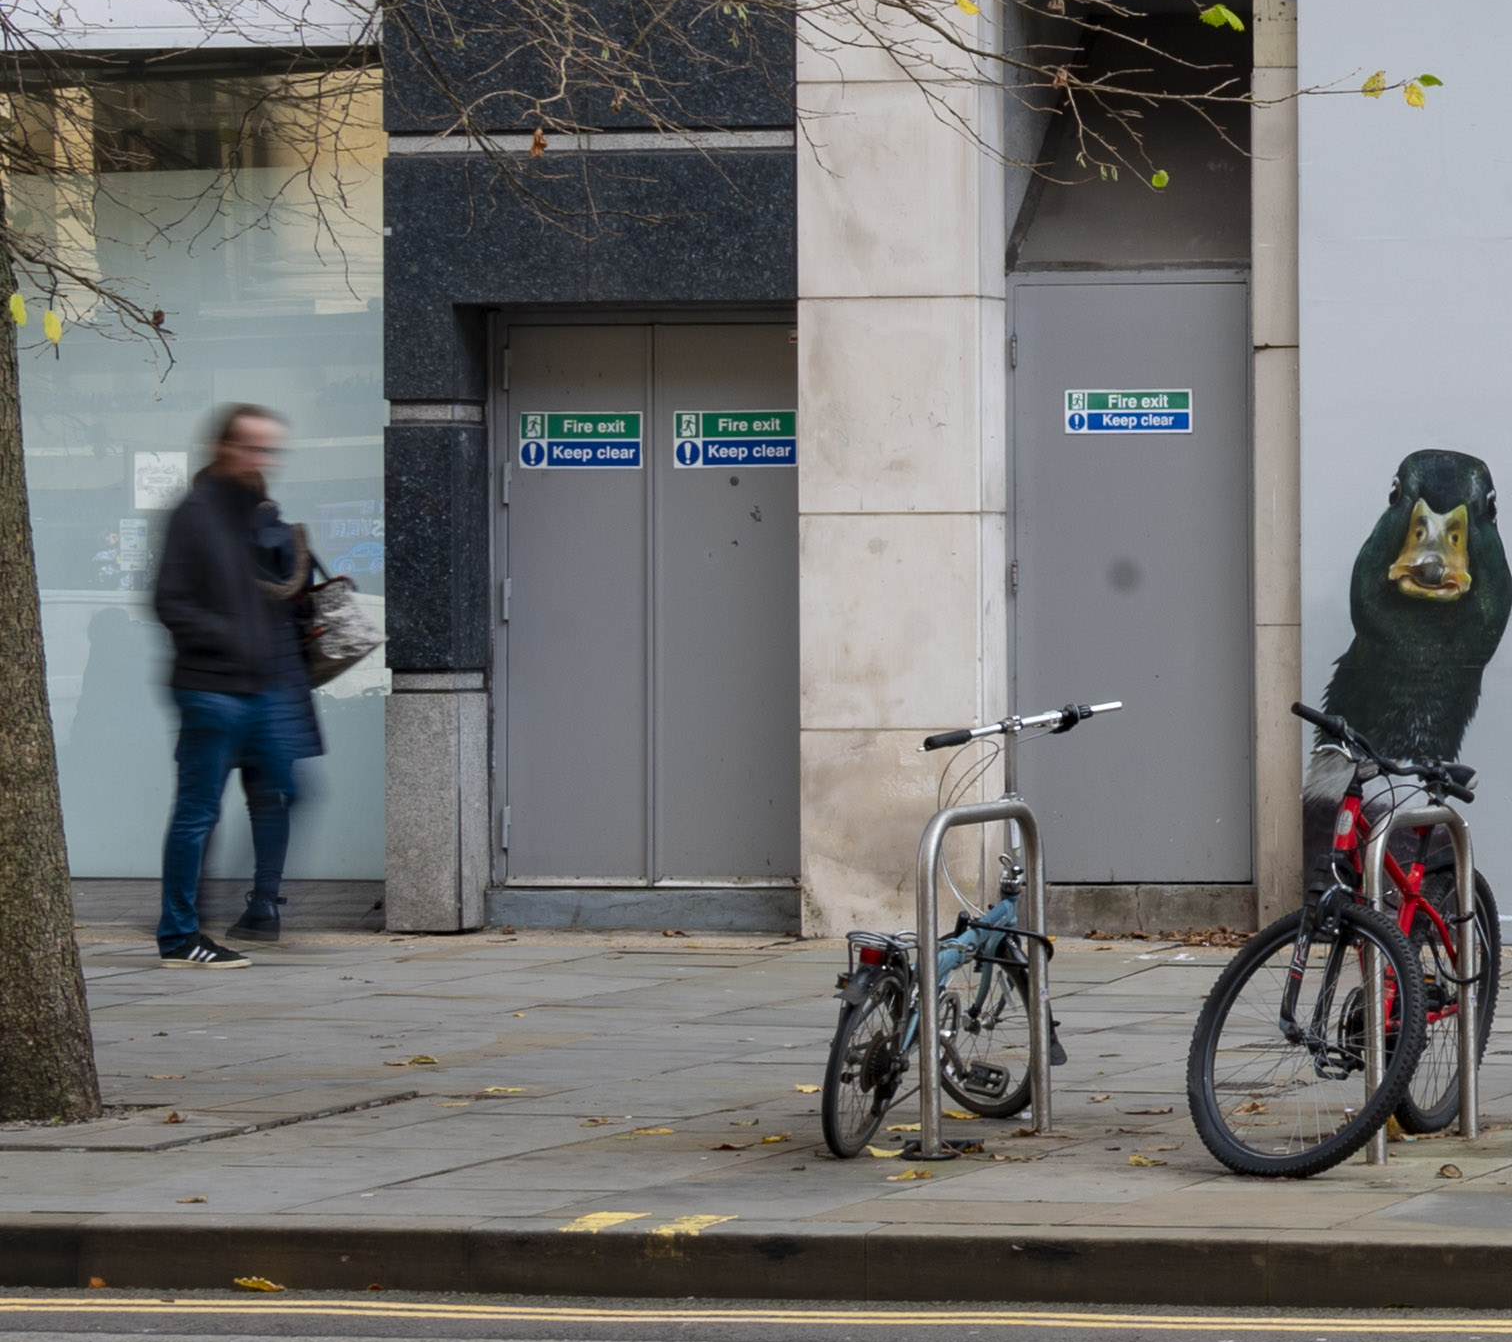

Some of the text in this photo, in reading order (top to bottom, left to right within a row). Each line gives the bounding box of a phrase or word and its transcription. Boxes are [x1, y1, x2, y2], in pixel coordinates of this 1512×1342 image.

[1108, 395, 1168, 408] Fire exit
[563, 419, 625, 433] Fire exit
[718, 418, 781, 432] Fire exit
[1103, 414, 1174, 429] Keep clear
[553, 446, 636, 461] Keep clear
[708, 444, 792, 460] Keep clear
